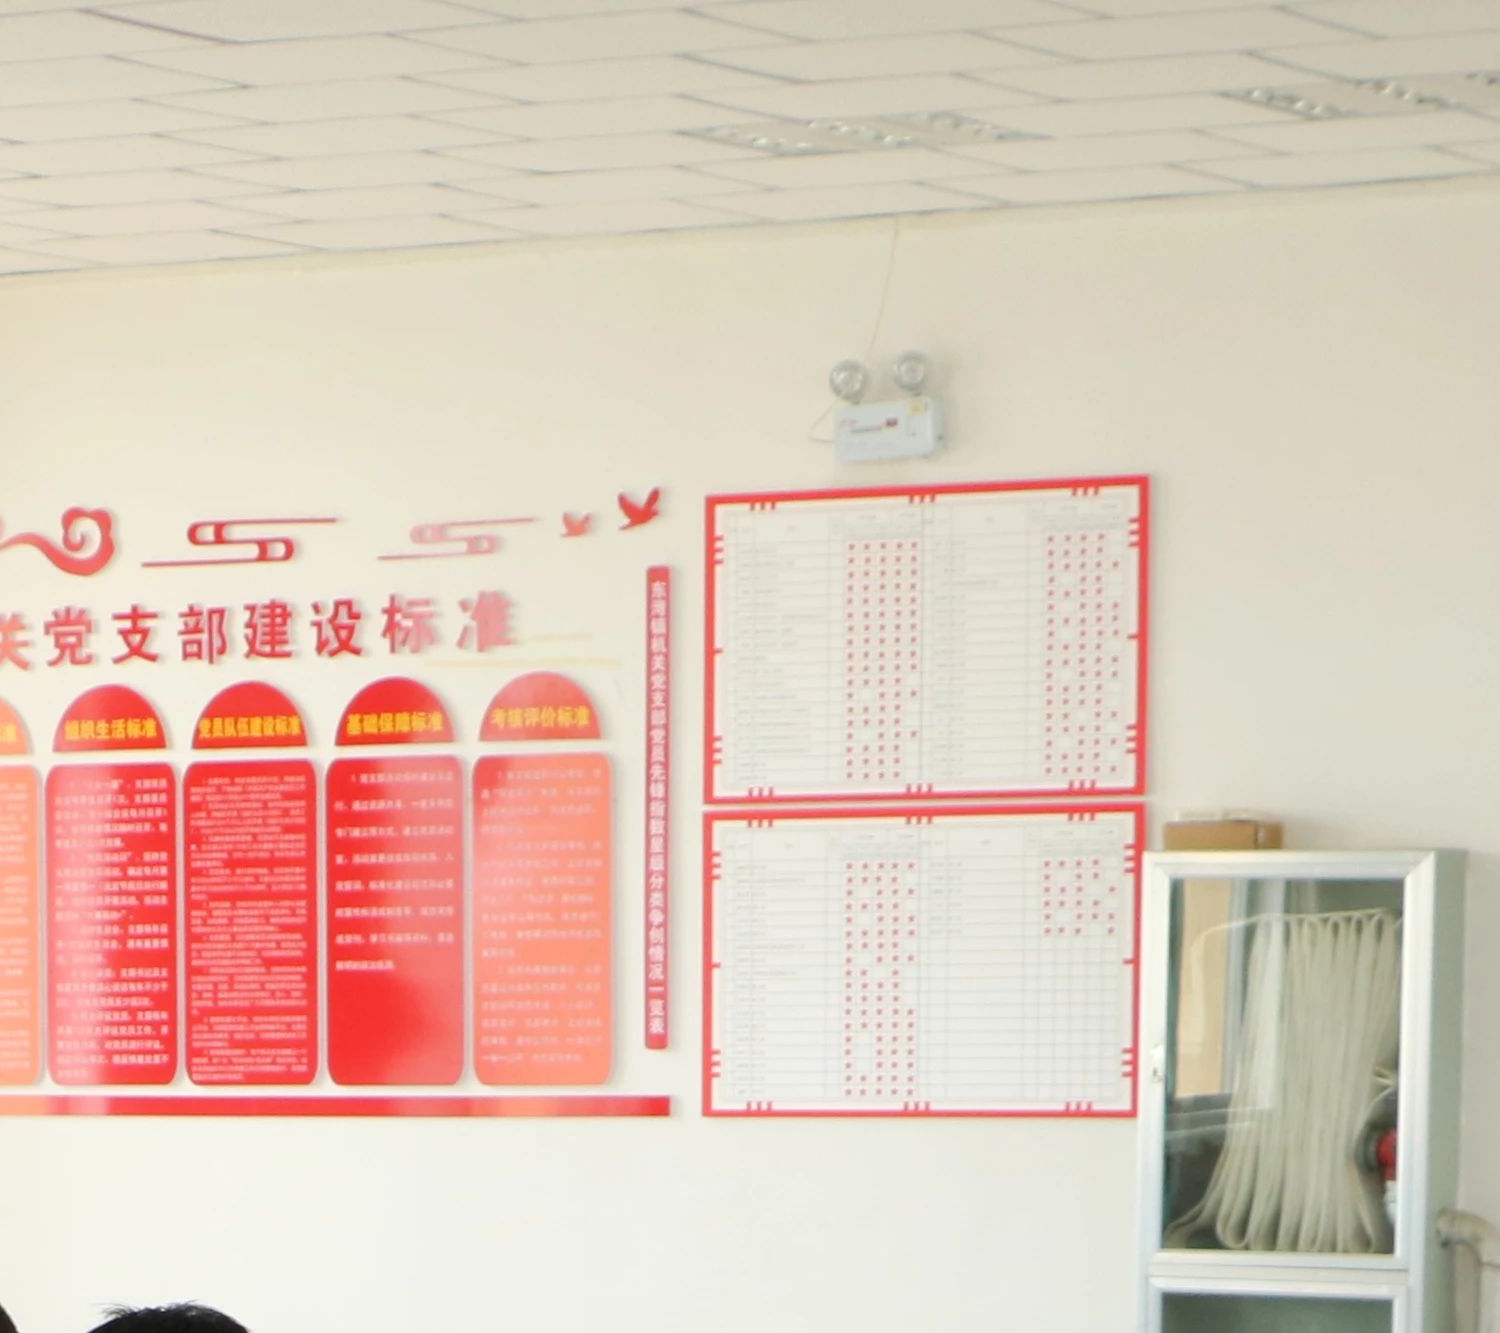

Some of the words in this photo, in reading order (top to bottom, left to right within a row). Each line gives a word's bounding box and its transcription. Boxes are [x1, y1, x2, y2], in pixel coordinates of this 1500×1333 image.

[64, 717, 157, 741] 组织生活标准
[198, 715, 302, 738] 党员队伍建设标准
[346, 710, 444, 736] 基础保障标准
[491, 705, 591, 729] 考核评价标准
